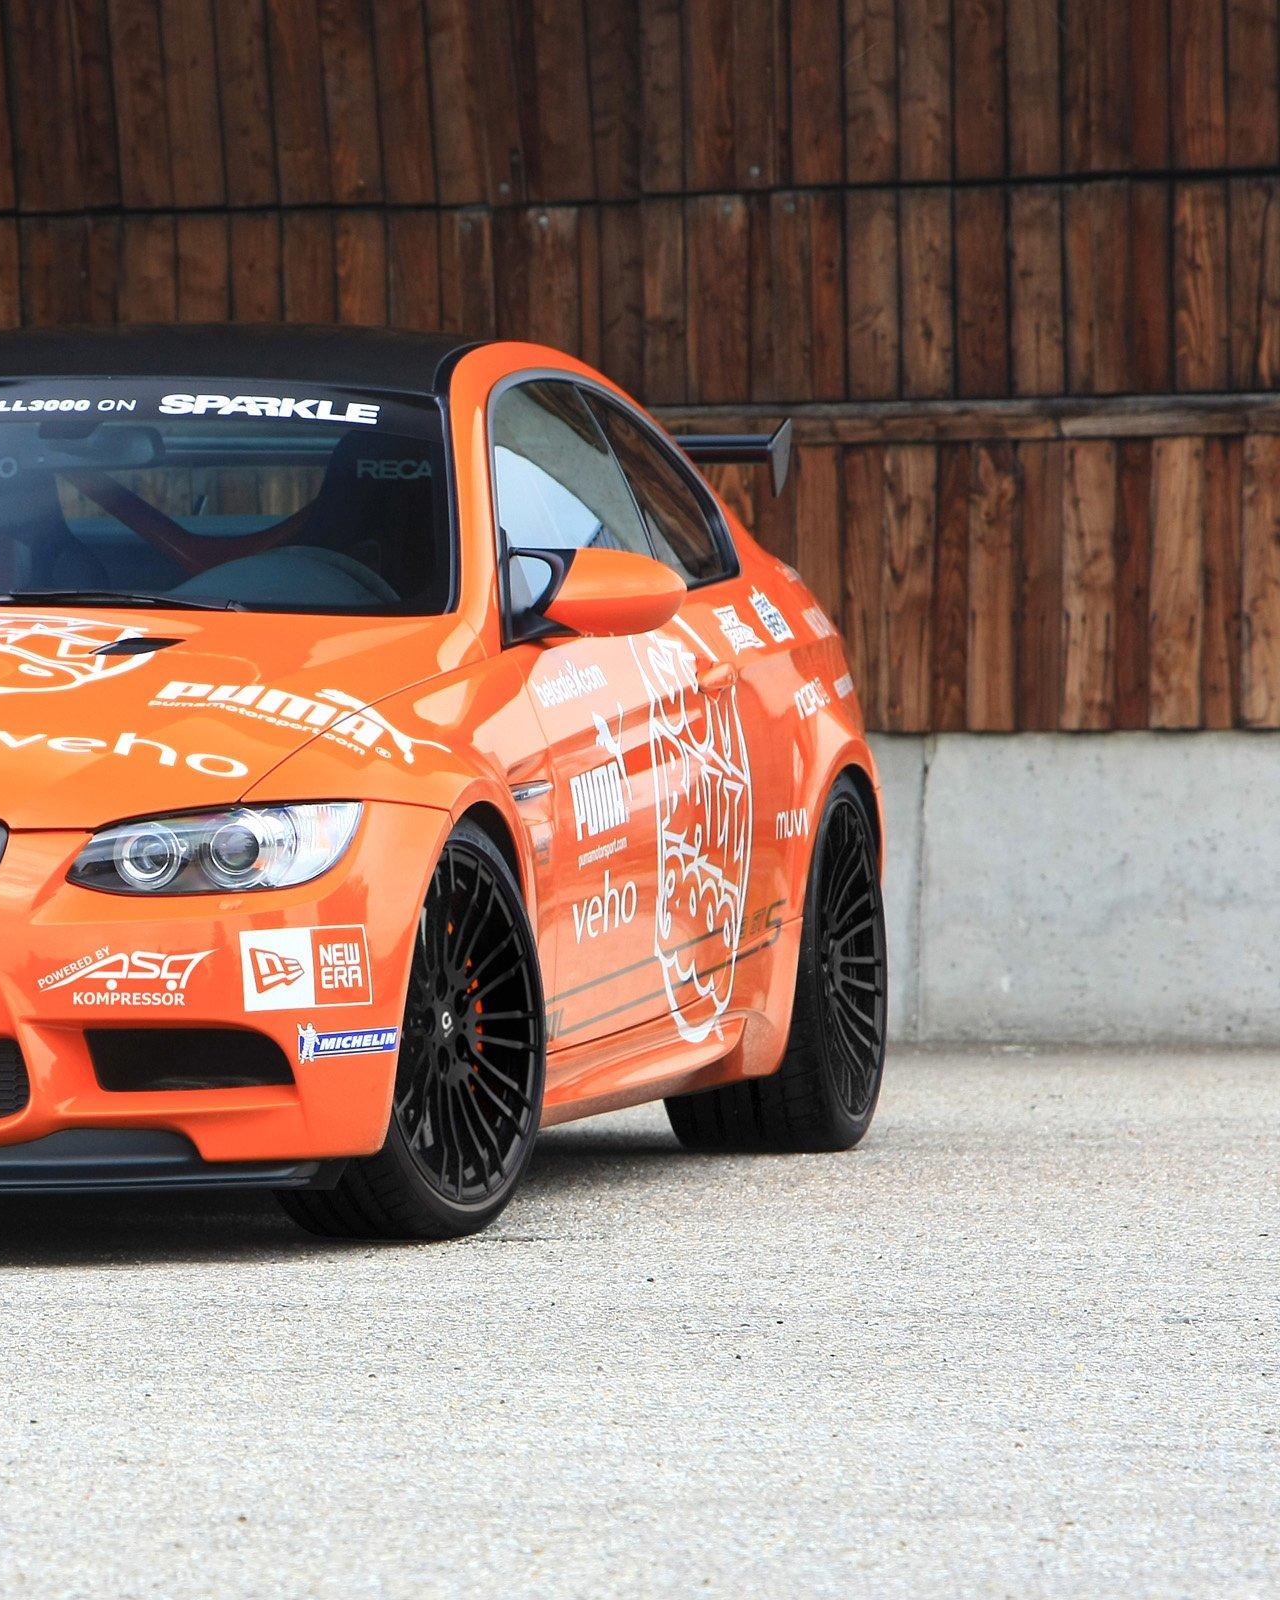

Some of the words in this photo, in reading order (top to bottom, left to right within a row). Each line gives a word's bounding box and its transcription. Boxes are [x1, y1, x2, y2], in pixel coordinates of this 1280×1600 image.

[97, 399, 136, 411] ON
[158, 394, 380, 425] SPARKLE
[357, 459, 432, 479] RECA
[156, 681, 384, 747] PUMA
[570, 761, 626, 842] PUMA
[572, 869, 638, 945] veho
[319, 942, 360, 966] NEW
[37, 954, 93, 989] POWERED
[94, 946, 111, 959] BY
[322, 965, 363, 990] ERA
[72, 991, 186, 1006] KOMPRESSOR
[320, 1032, 396, 1051] MICHELIN
